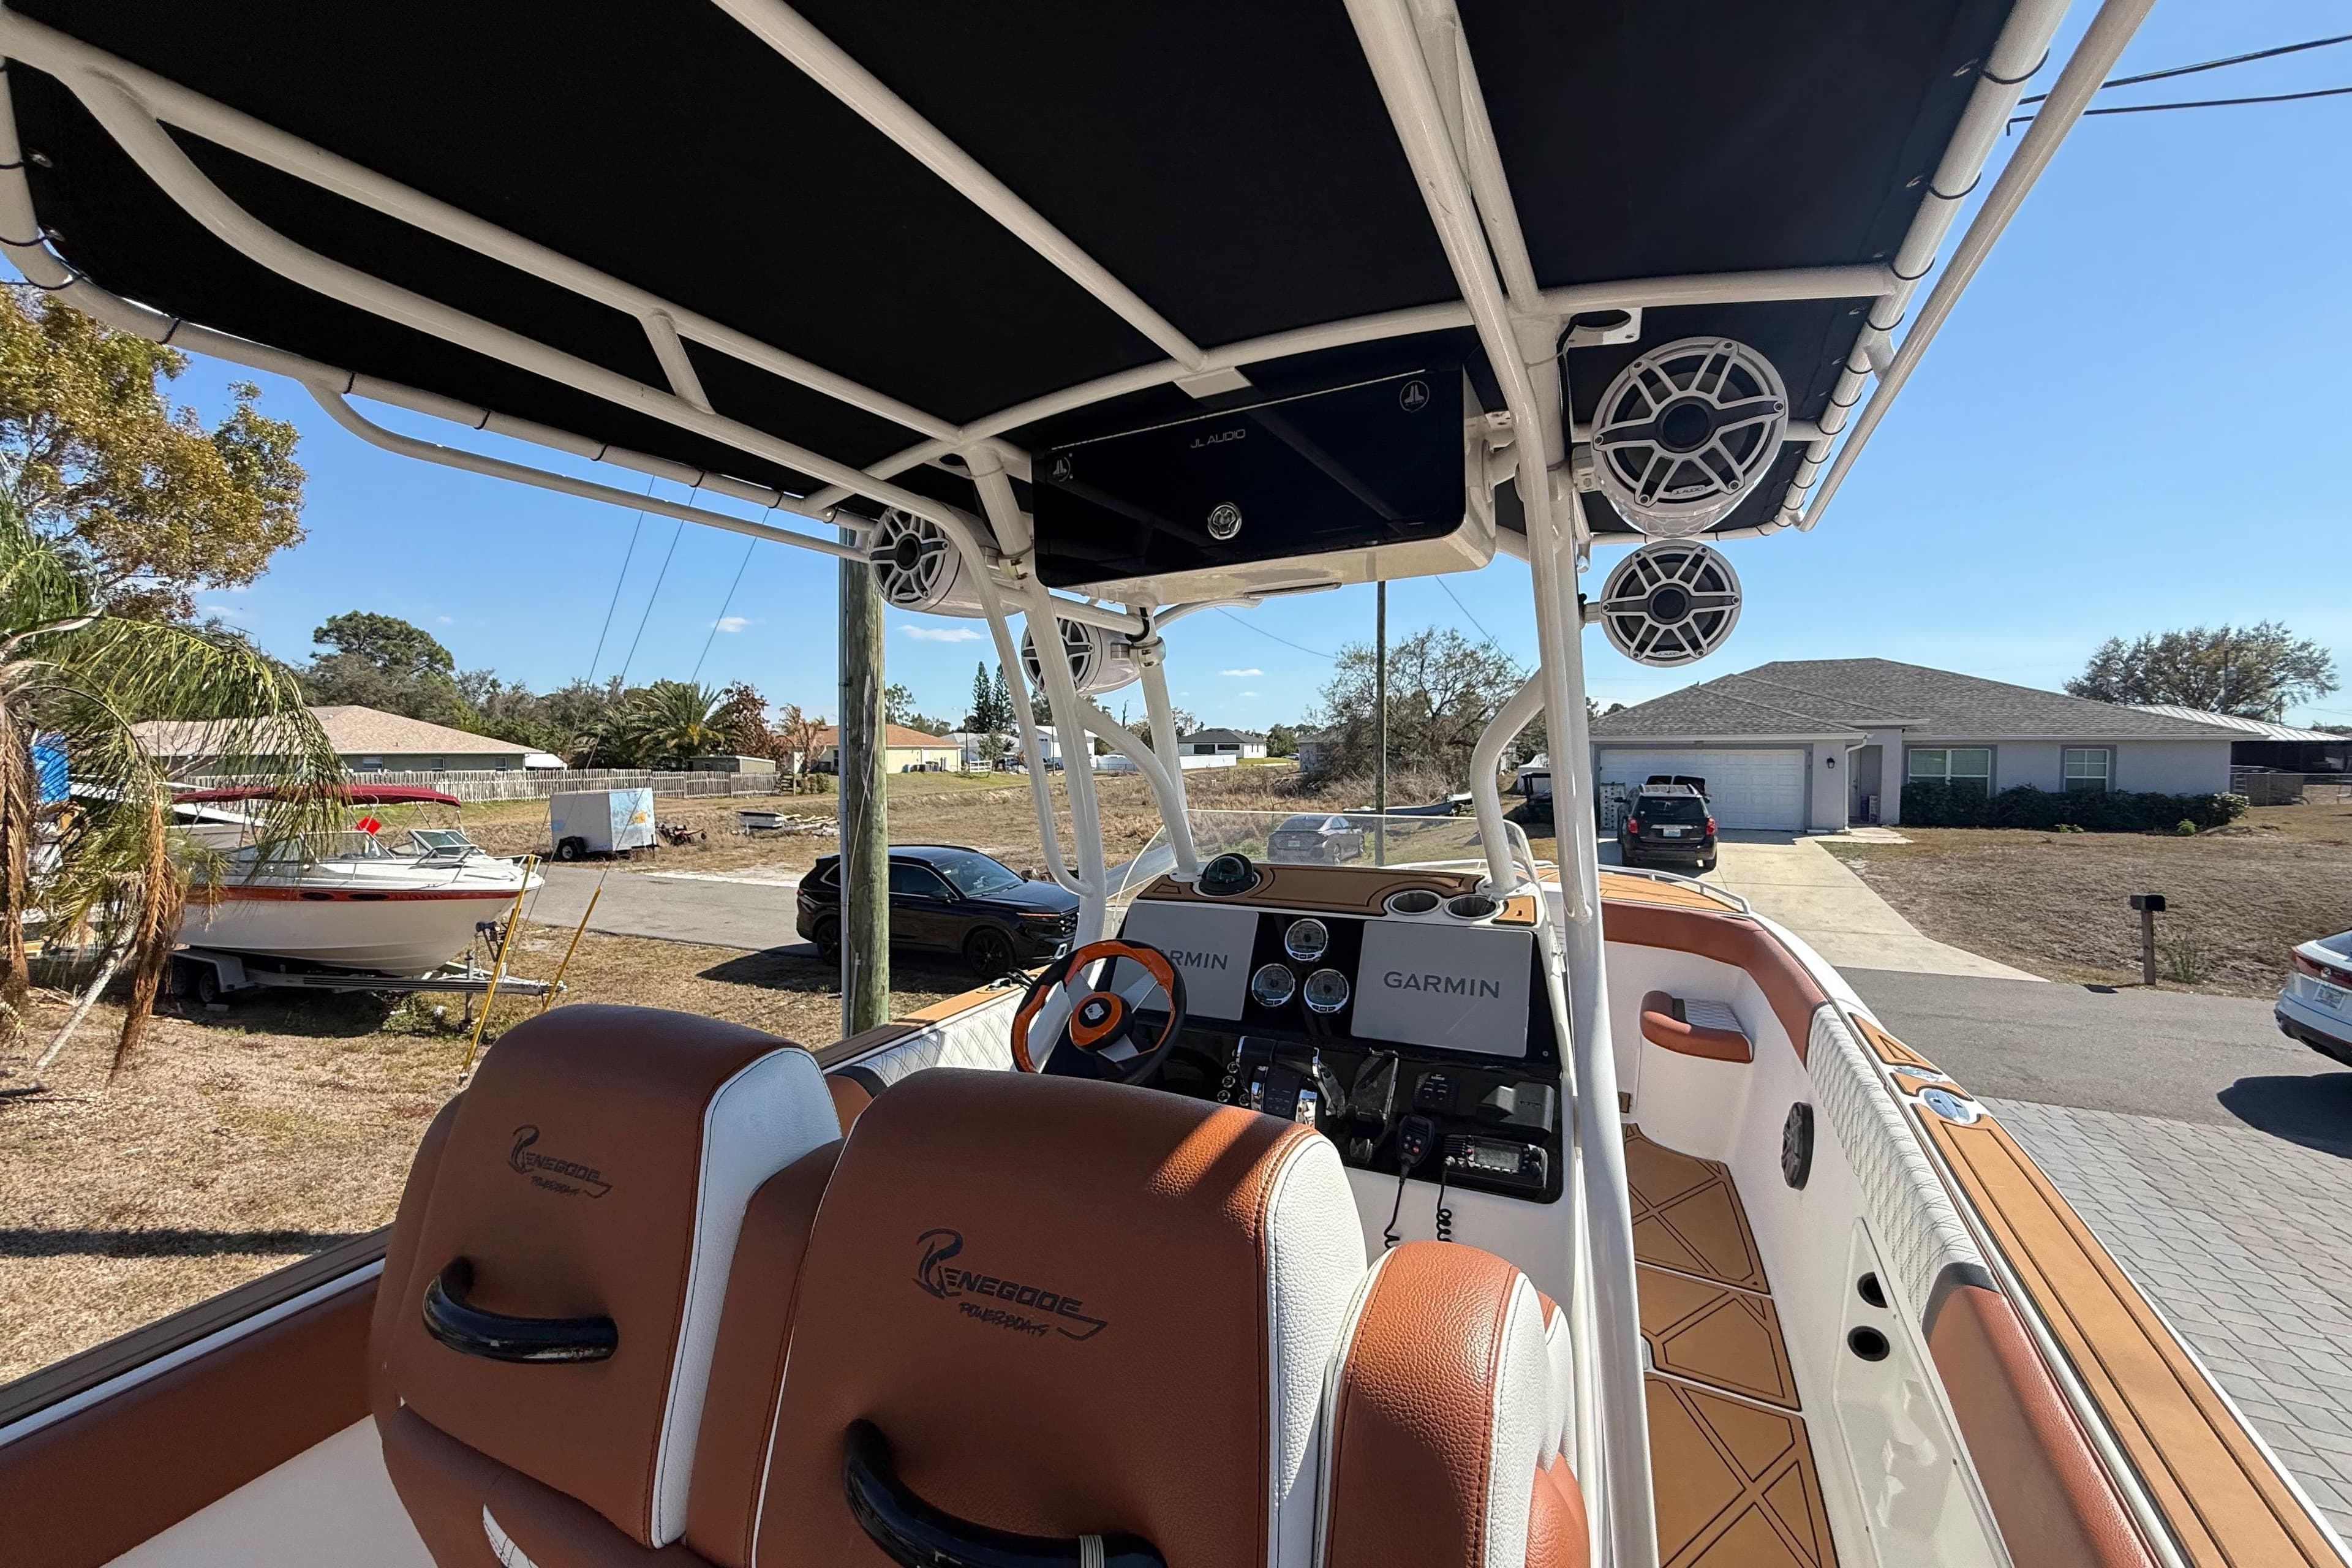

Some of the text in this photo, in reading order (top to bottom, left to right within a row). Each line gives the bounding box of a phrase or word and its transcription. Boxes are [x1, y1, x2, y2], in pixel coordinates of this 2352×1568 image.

[1190, 429, 1246, 448] JL AUDIO
[1161, 949, 1228, 970] RMIN
[1384, 971, 1499, 999] GARMIN
[959, 1301, 1050, 1337] POWERBOATS
